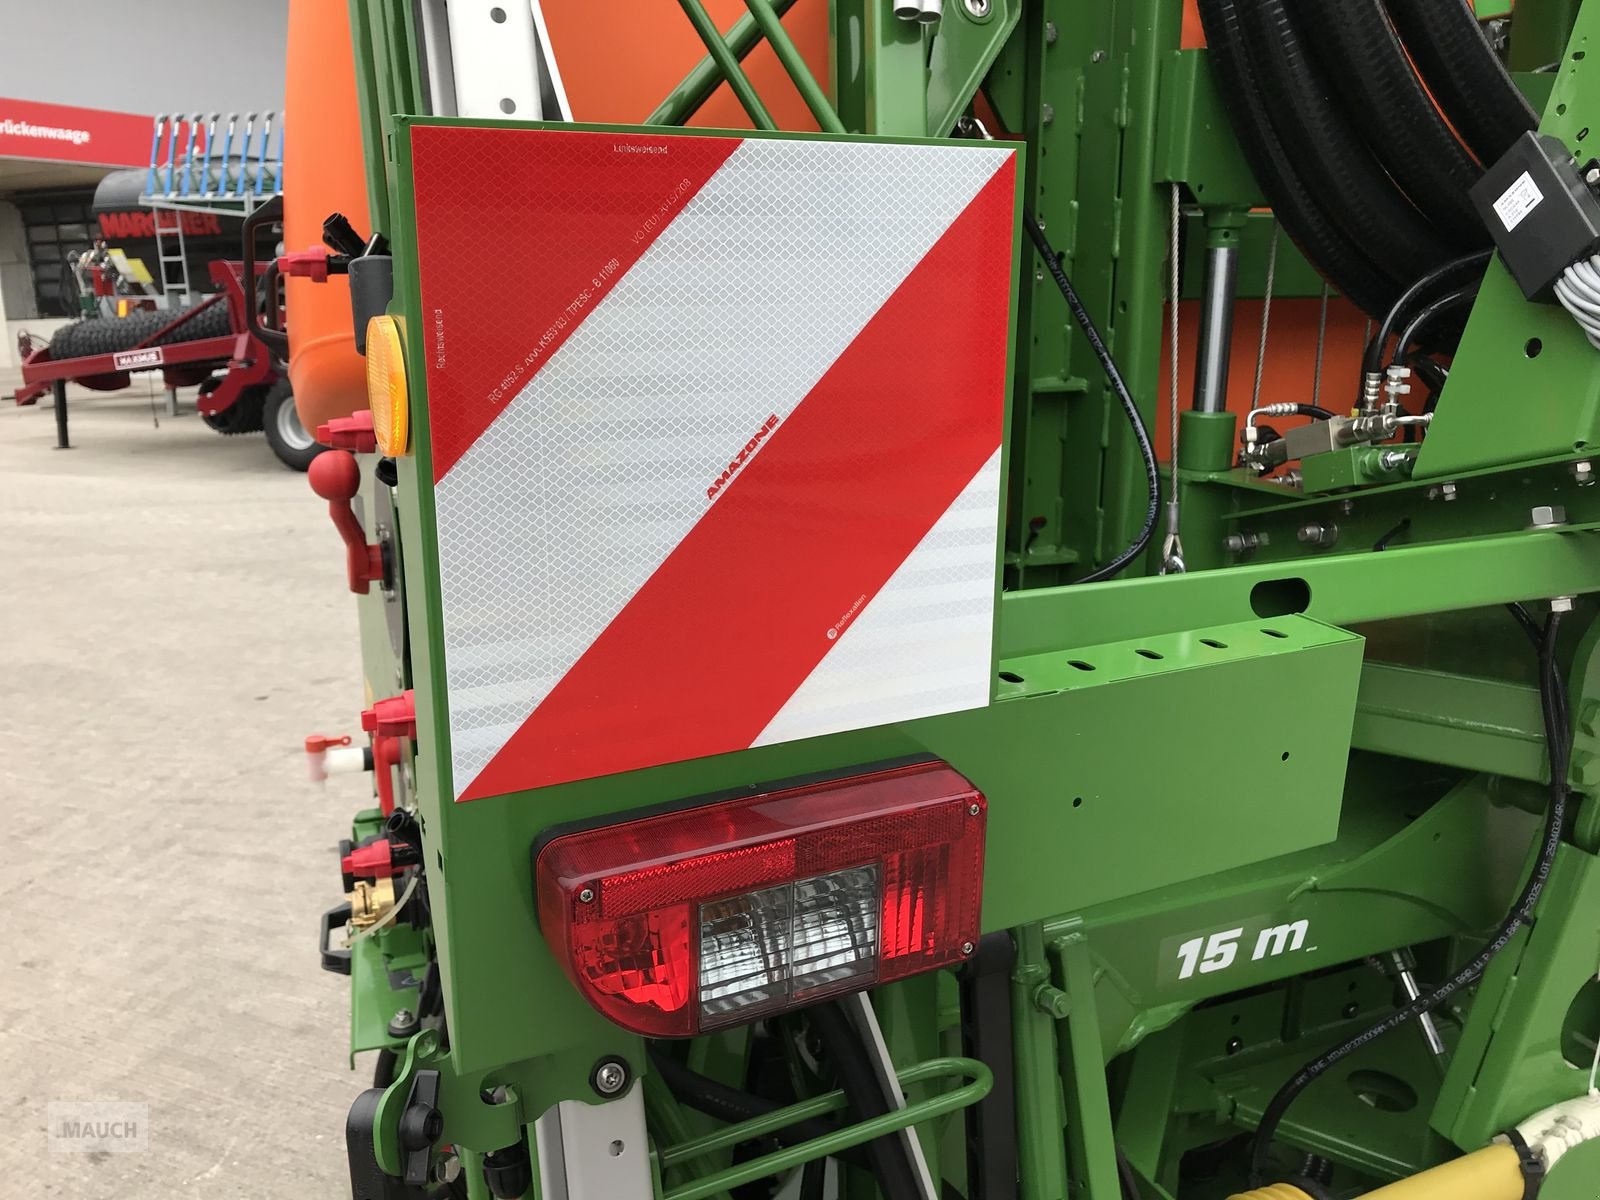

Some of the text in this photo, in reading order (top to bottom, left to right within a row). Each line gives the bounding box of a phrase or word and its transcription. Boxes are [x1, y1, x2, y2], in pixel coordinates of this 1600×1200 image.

[434, 309, 446, 369] Rechtsweisend
[487, 388, 503, 404] RG
[707, 414, 779, 500] AMAZONE
[1176, 919, 1310, 980] 15 m
